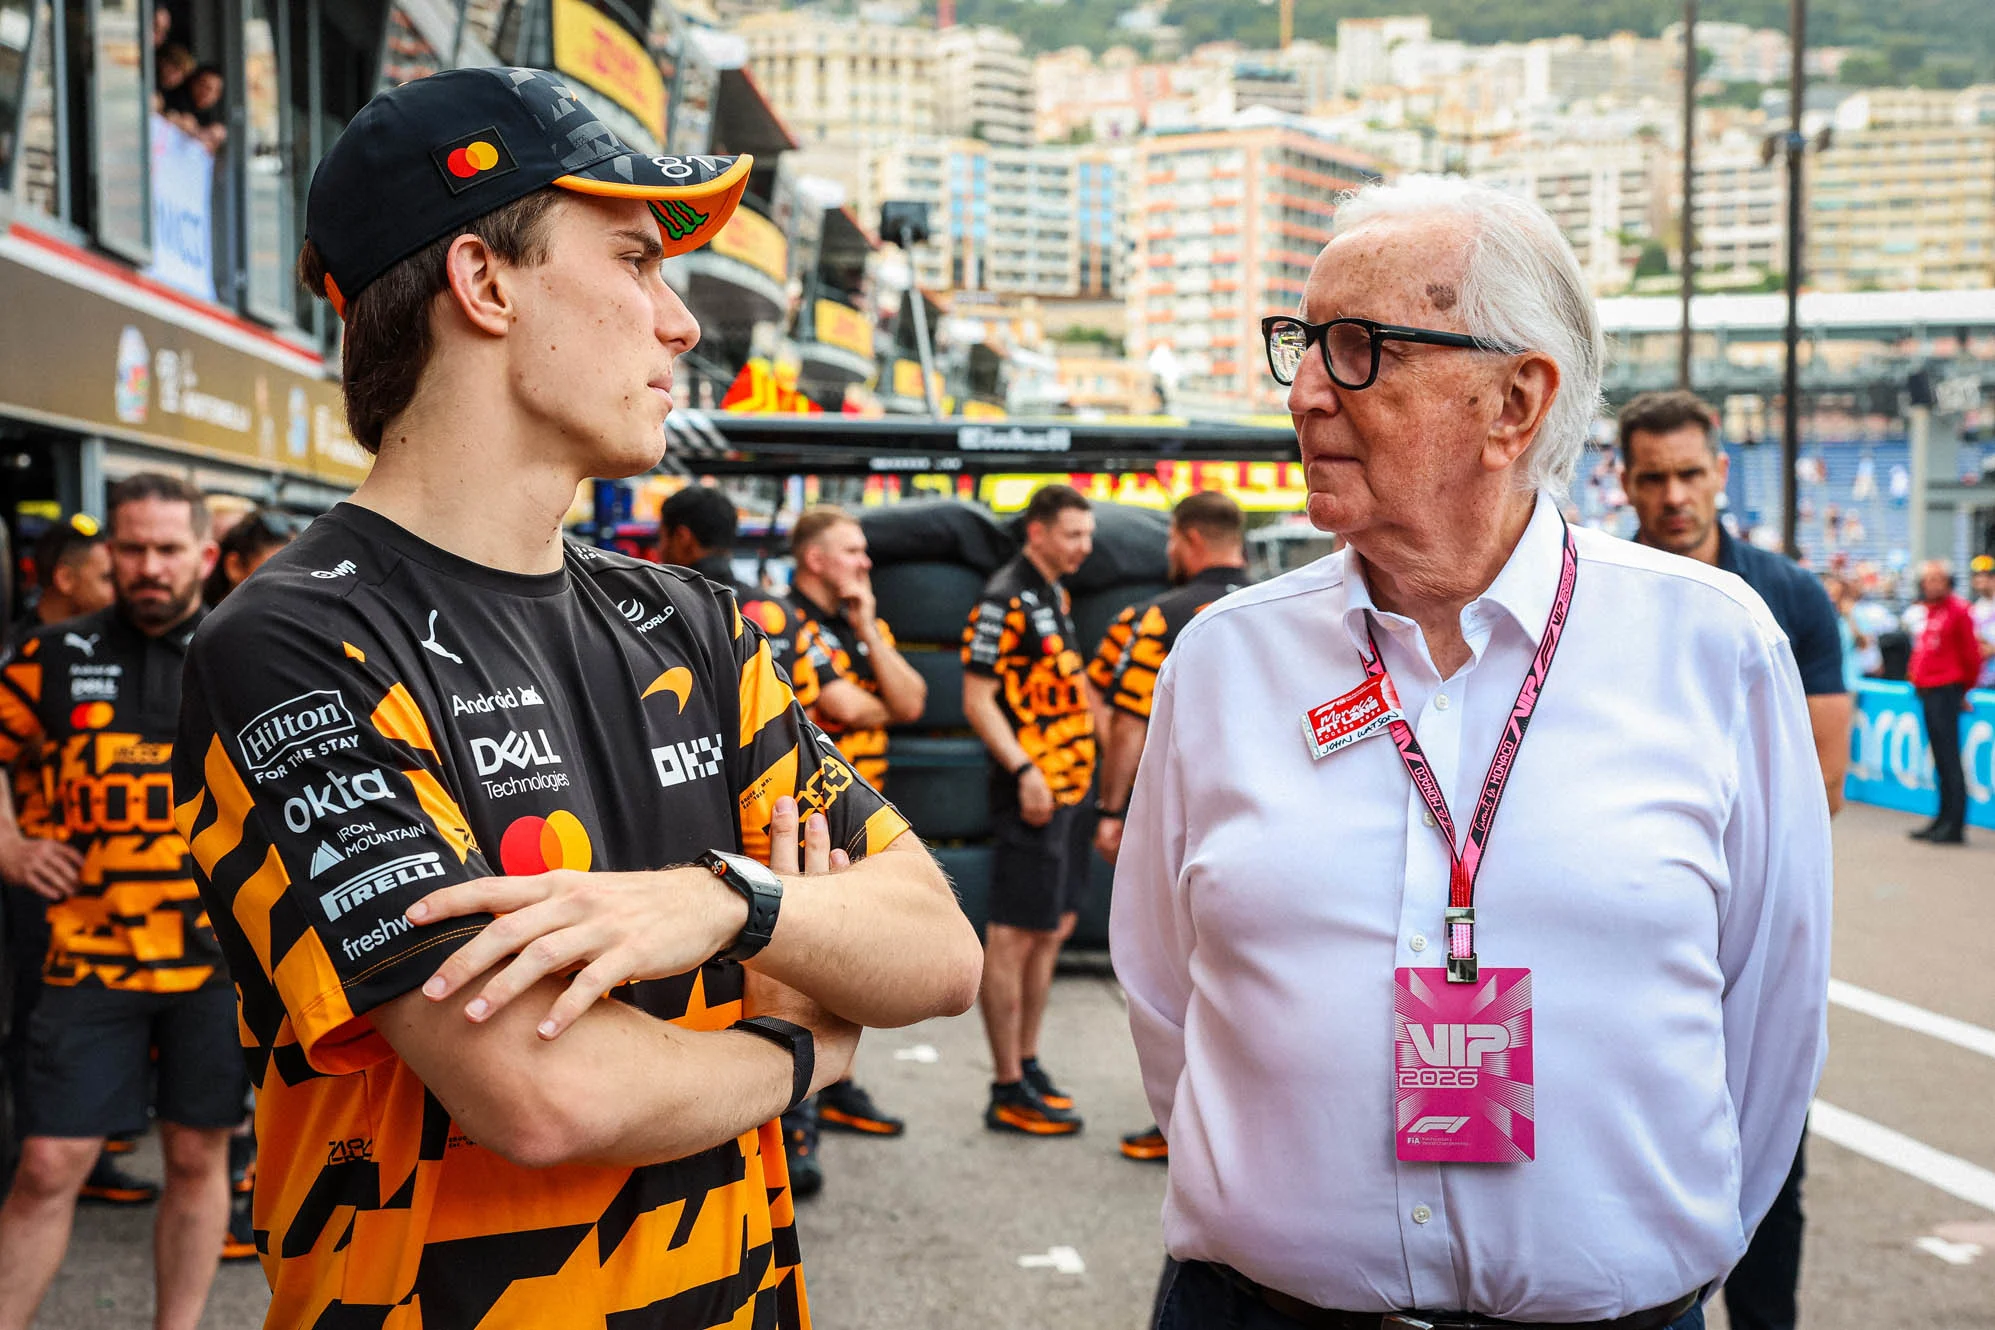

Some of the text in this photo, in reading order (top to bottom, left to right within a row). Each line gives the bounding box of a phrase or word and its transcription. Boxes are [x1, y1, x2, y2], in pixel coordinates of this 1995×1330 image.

[452, 687, 519, 717] Android
[1320, 695, 1374, 727] Monaco
[246, 702, 342, 761] Hilton
[469, 728, 562, 777] DELL
[1322, 711, 1400, 755] JOHN WATSON
[254, 734, 360, 785] FOR THE STAY
[1489, 740, 1514, 785] MONACO
[284, 768, 397, 834] okta
[481, 770, 570, 800] Technologies
[1414, 766, 1441, 807] MONACO
[336, 821, 377, 843] IRON
[344, 823, 427, 859] MOUNTAIN
[319, 851, 446, 922] PIRELLI
[342, 914, 416, 961] freshw
[1405, 1023, 1511, 1067] VIP
[1399, 1067, 1478, 1088] 2026
